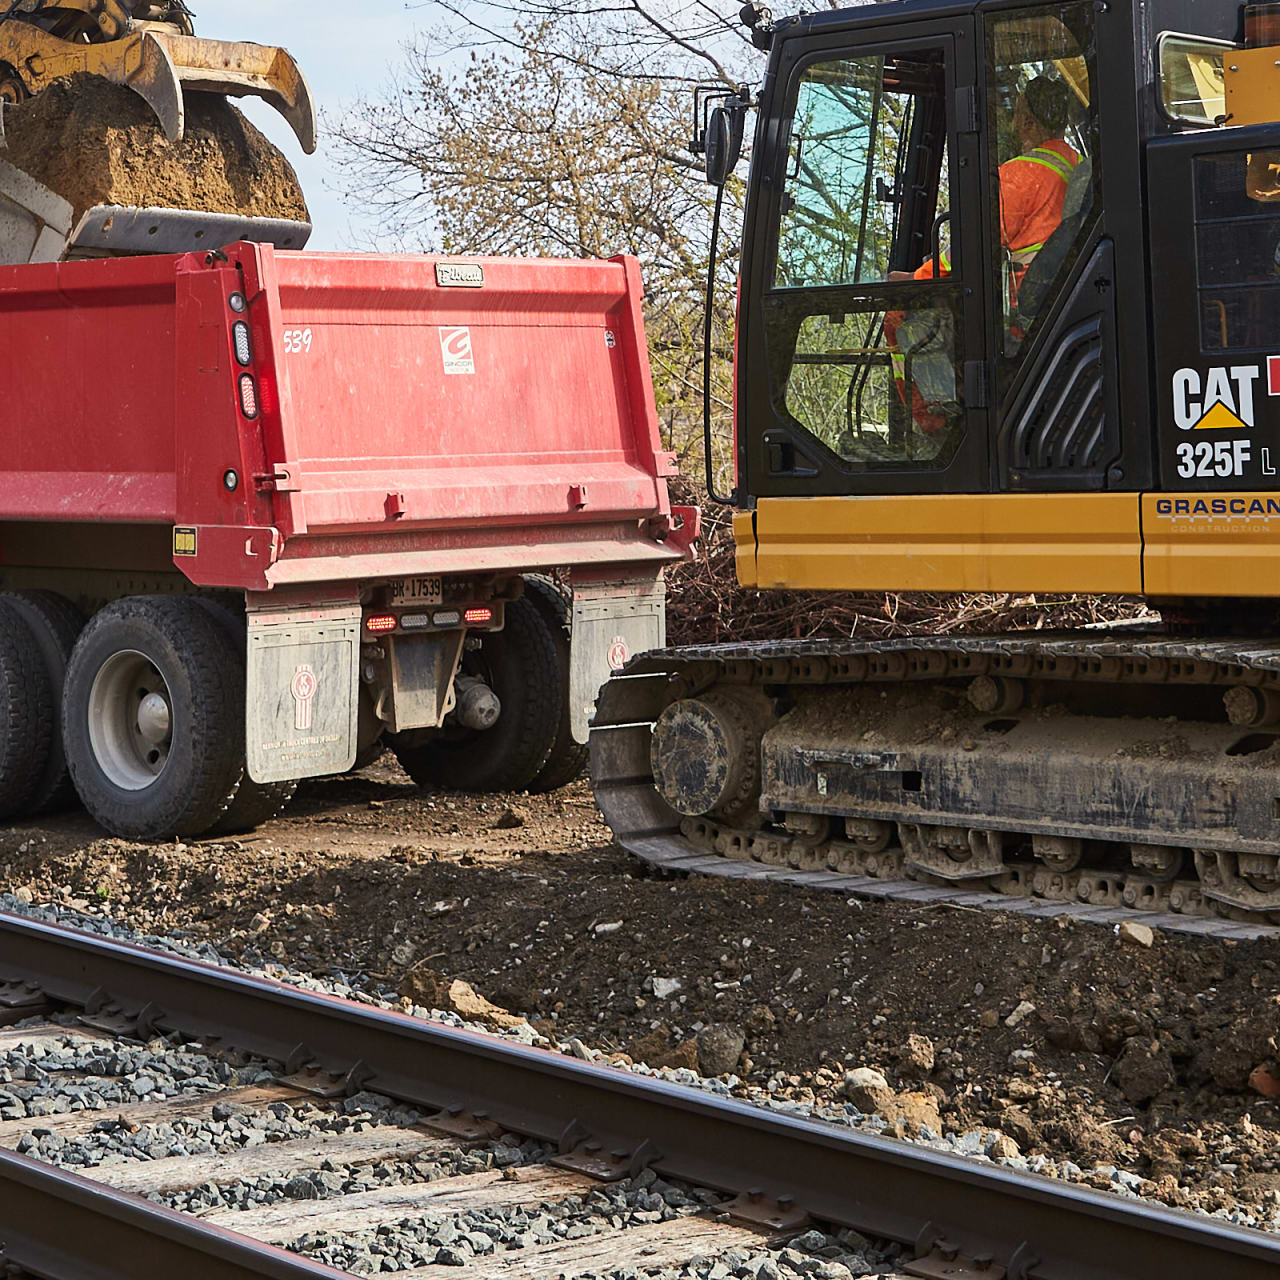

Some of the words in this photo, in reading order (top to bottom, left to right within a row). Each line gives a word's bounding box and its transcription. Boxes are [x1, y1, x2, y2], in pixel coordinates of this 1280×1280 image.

[283, 327, 312, 353] 539
[1172, 365, 1259, 430] CAT
[1176, 439, 1251, 479] 325F
[1261, 447, 1276, 475] L
[1171, 524, 1271, 534] CONSTRUCTION
[411, 578, 441, 597] 17539
